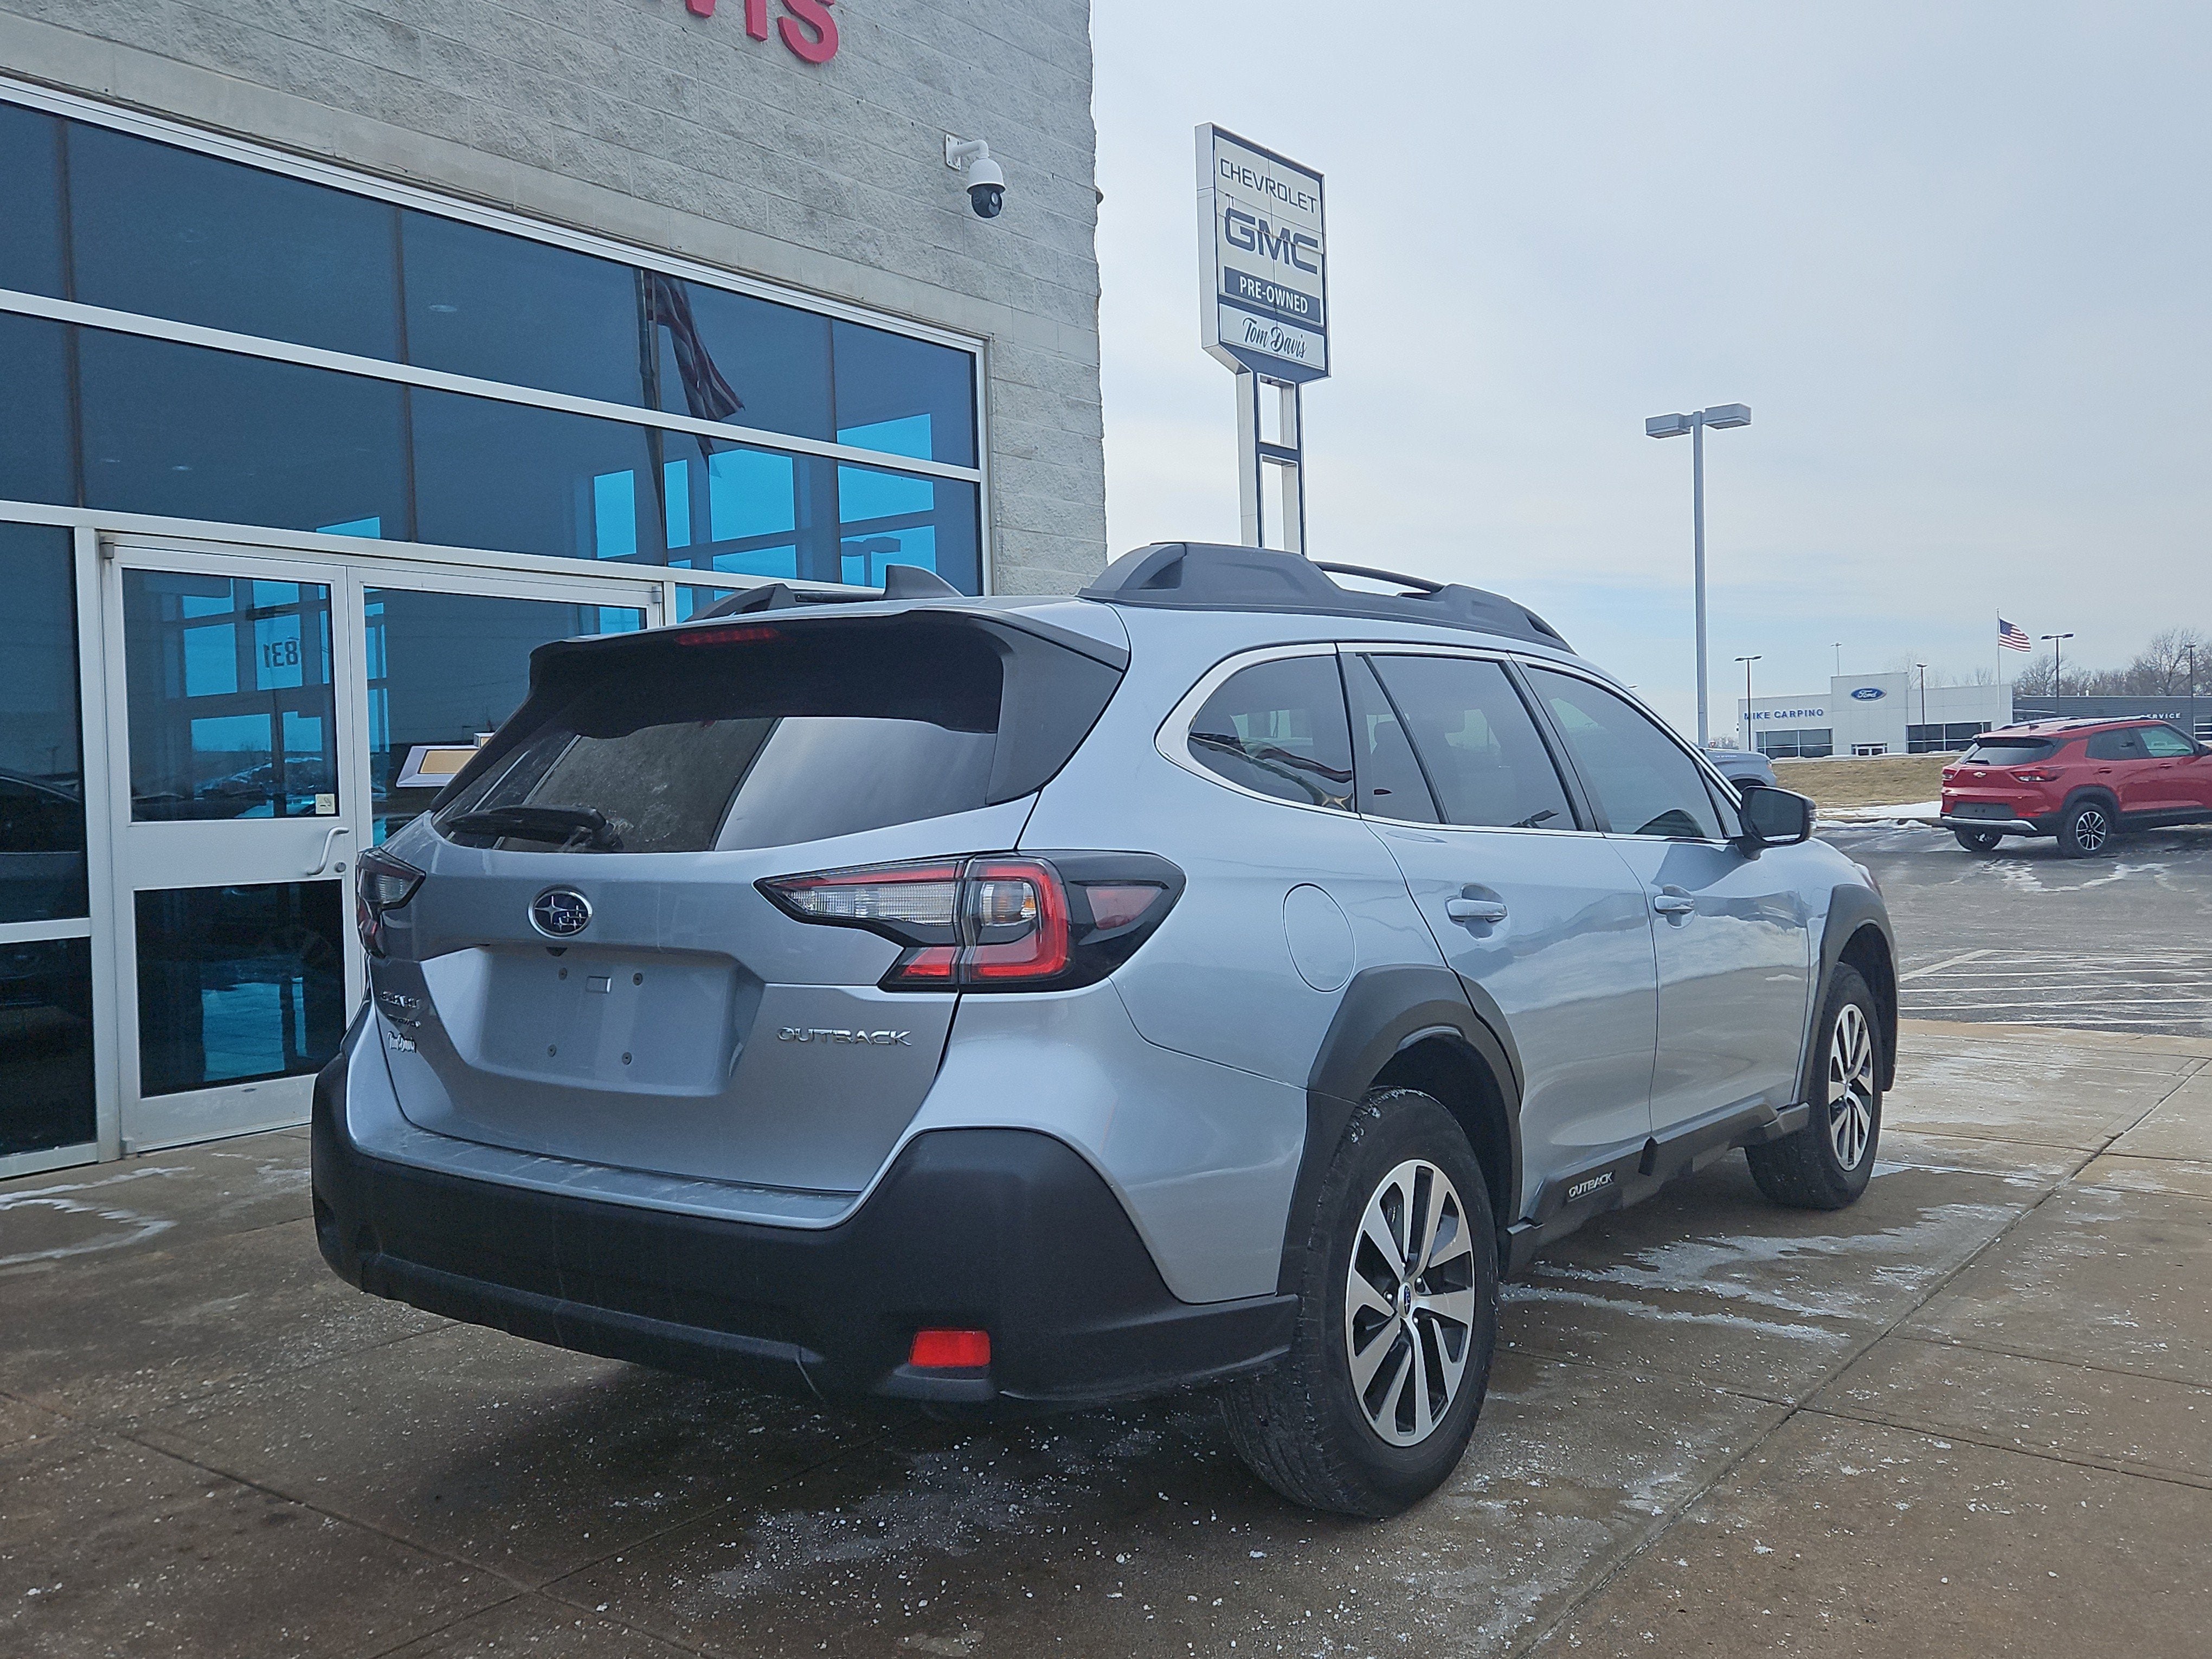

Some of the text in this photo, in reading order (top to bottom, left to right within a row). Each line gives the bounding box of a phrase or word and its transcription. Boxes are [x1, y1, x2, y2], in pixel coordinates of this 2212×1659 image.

[1220, 158, 1317, 214] CHEVROLET
[1225, 207, 1319, 275] GMC
[1239, 275, 1308, 314] PRE-OWNED
[1243, 318, 1307, 358] Tom Davis
[1857, 690, 1877, 698] Ford
[1774, 709, 1823, 718] CARPINO
[777, 1027, 912, 1046] OUTBACK
[1568, 1171, 1614, 1198] OUTBACK
